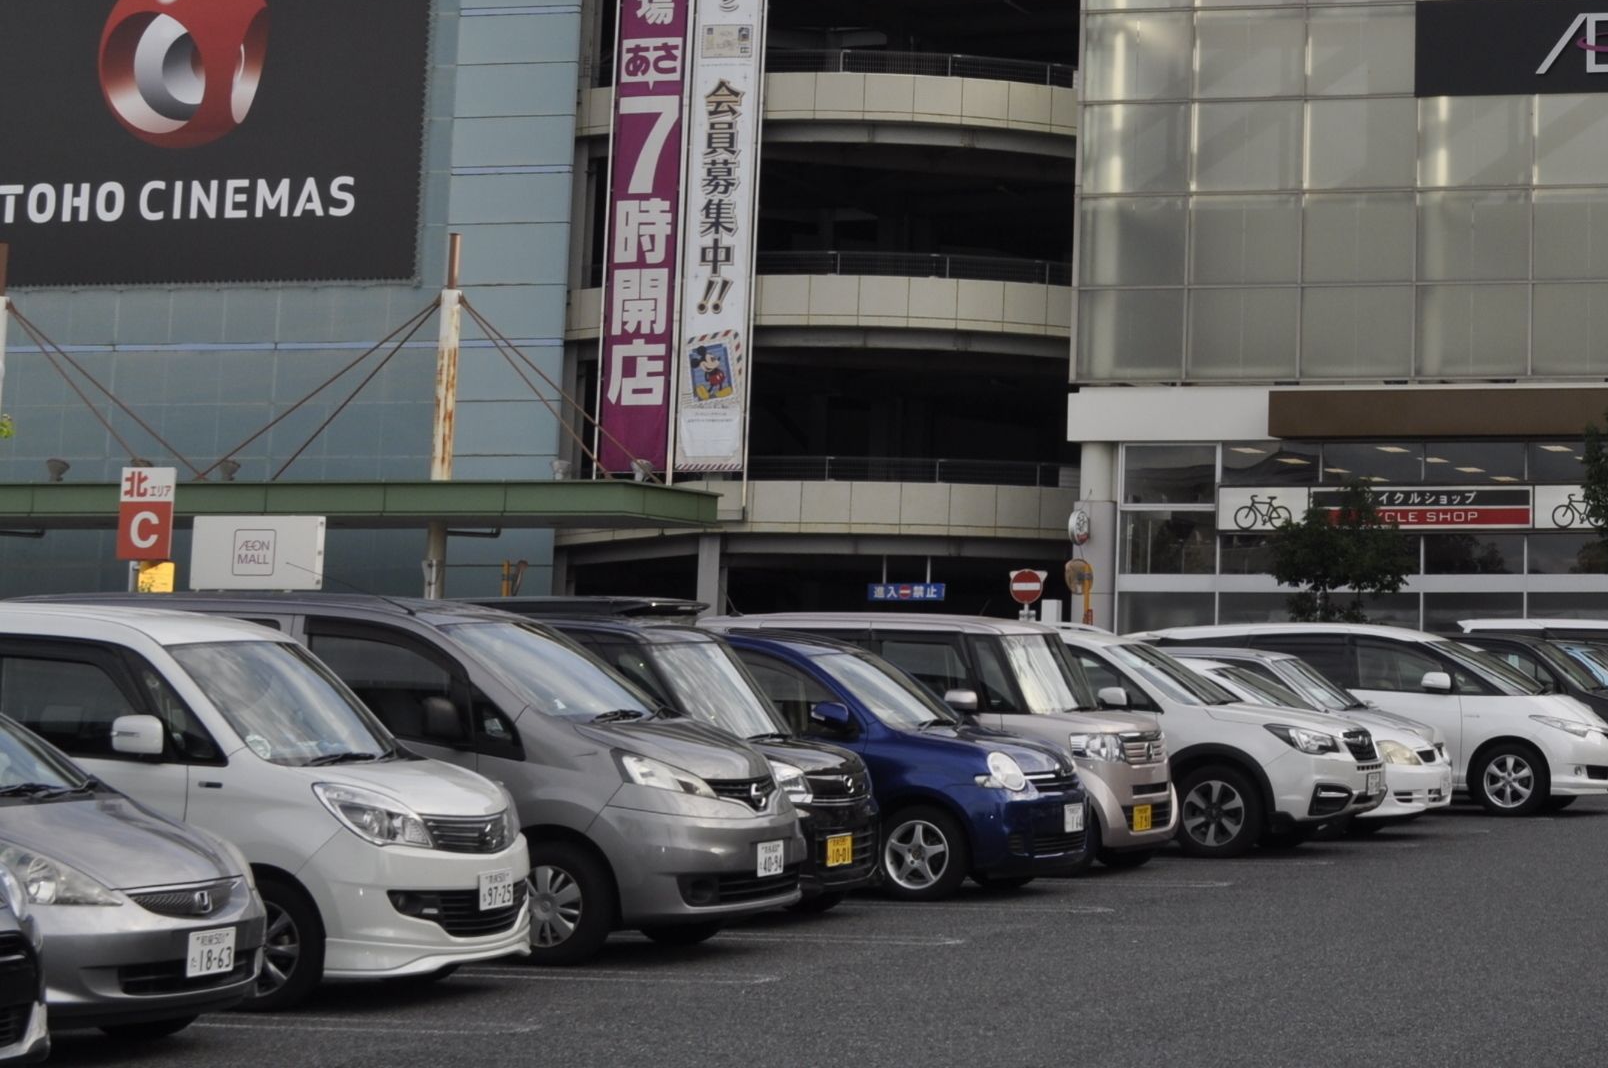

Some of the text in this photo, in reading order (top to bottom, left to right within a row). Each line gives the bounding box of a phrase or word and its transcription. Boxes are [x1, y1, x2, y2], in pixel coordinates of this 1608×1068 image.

[623, 42, 680, 77] あさ
[0, 176, 356, 224] TOHO CINEMAS
[607, 95, 679, 406] 7時開店
[123, 471, 172, 498] 北エリア
[1366, 491, 1478, 506] イクルショップ
[130, 511, 160, 549] C
[1425, 511, 1479, 523] SHOP
[236, 553, 270, 565] MALL
[199, 946, 233, 972] 18-63
